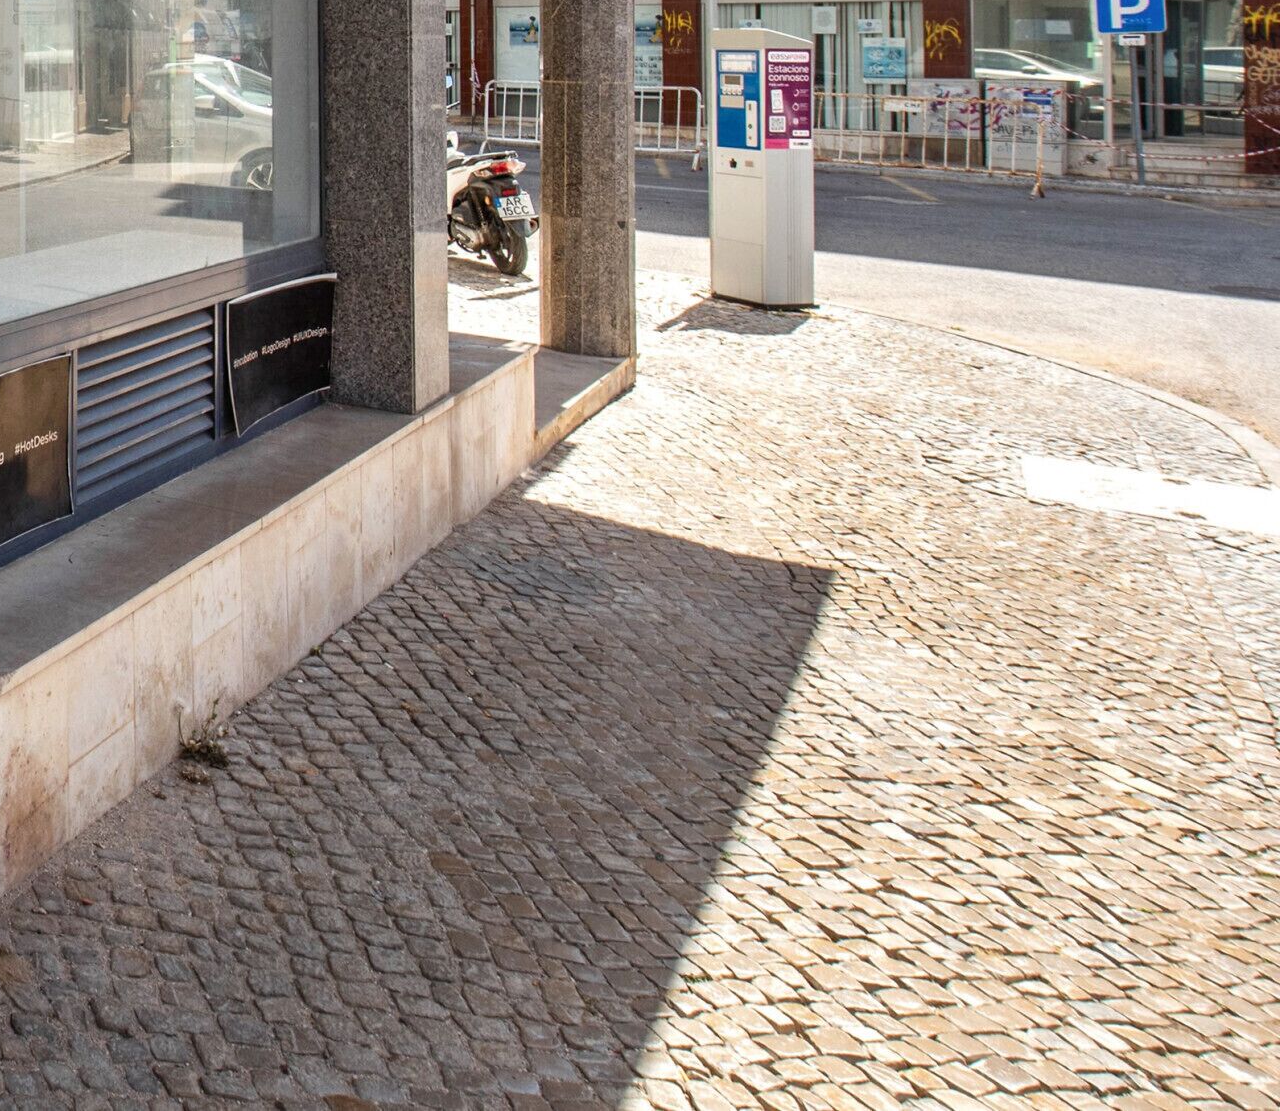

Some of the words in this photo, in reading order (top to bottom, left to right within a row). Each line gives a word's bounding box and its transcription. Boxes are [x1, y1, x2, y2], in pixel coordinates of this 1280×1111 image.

[768, 64, 809, 74] Estacione
[768, 74, 809, 82] connosco
[506, 196, 522, 206] AR
[502, 206, 529, 216] 15CC
[14, 430, 58, 455] #HotDesks
